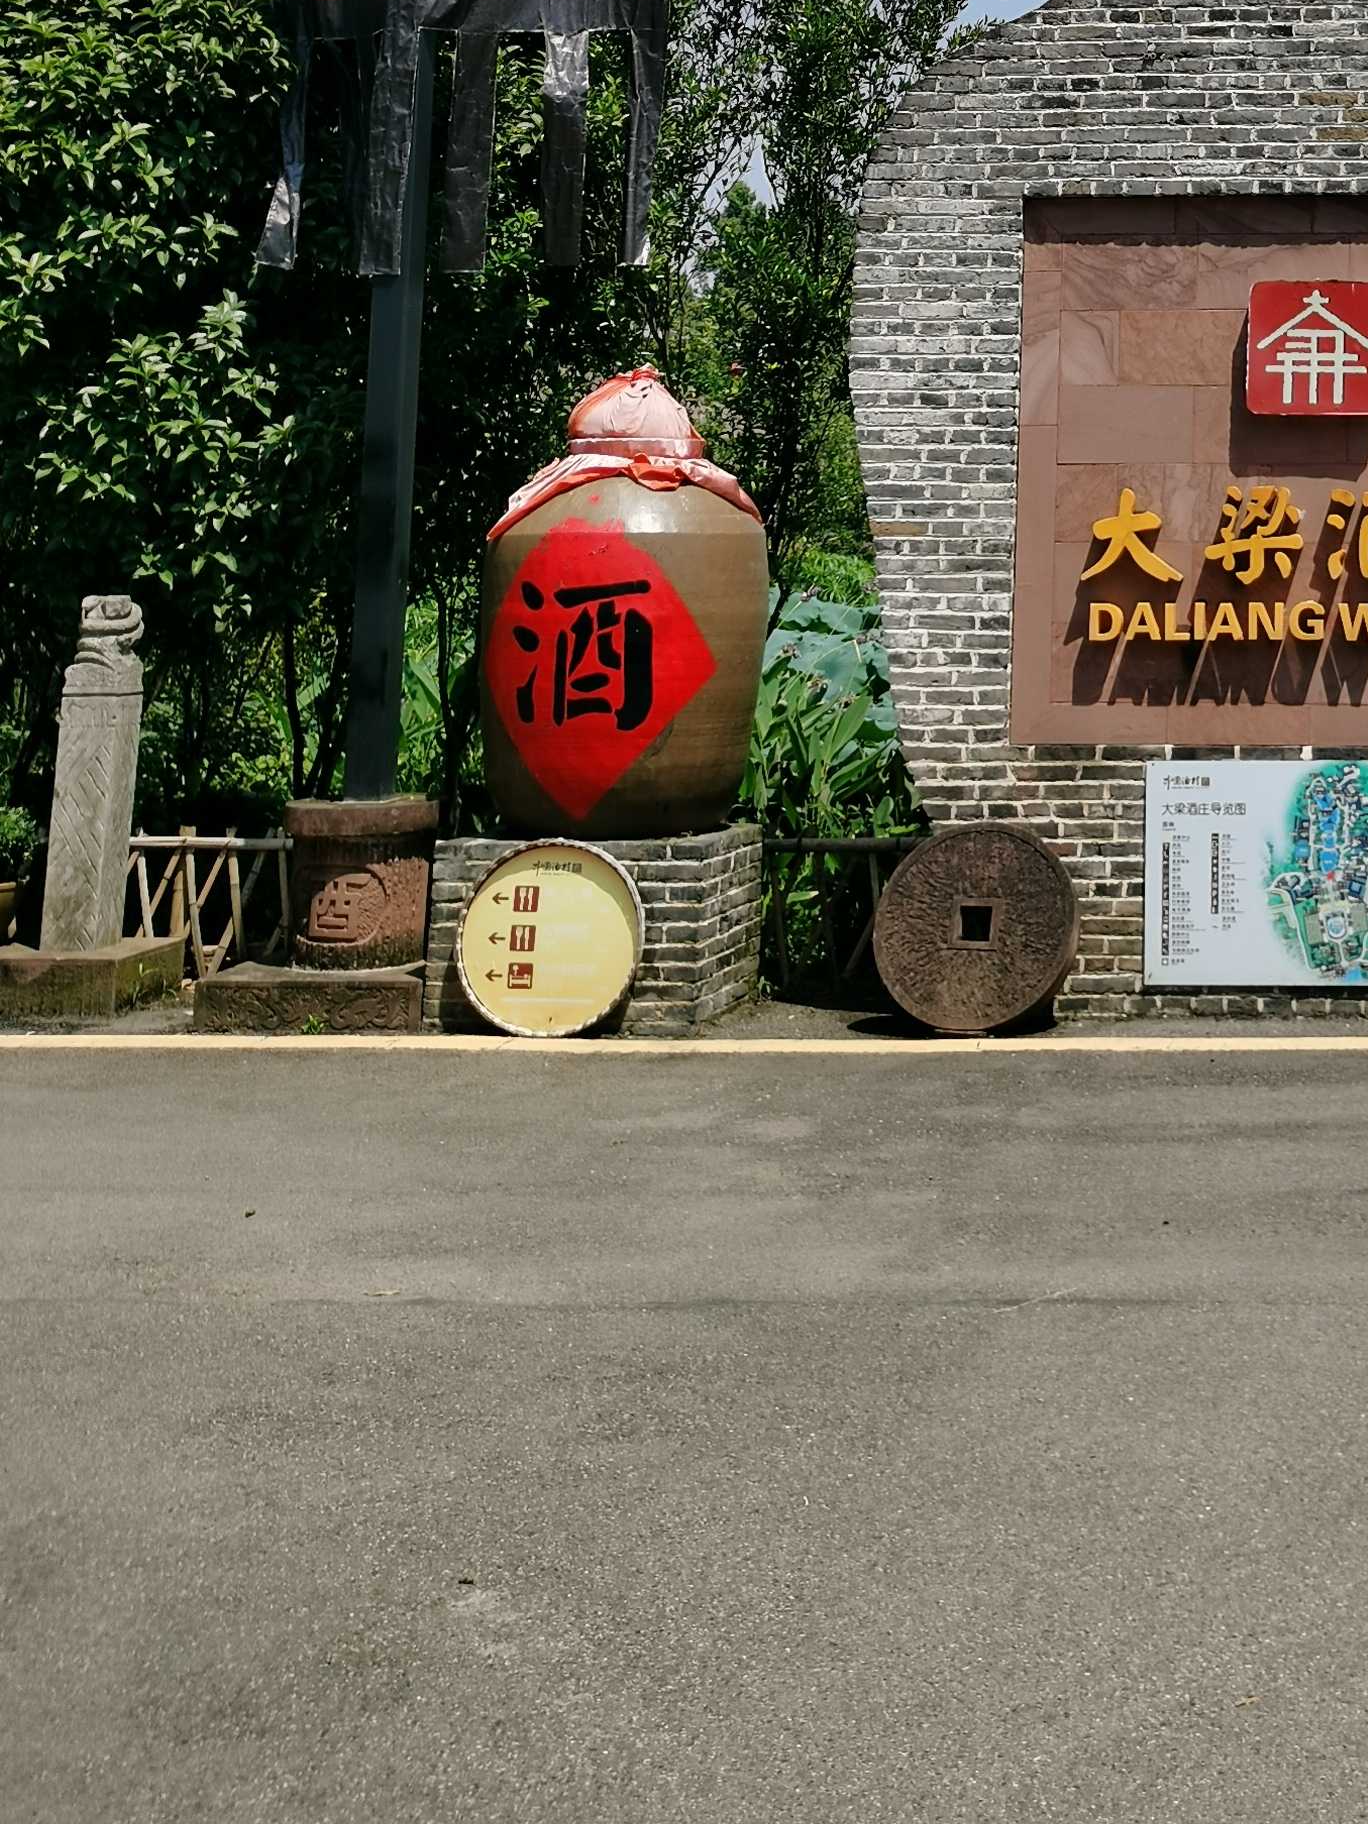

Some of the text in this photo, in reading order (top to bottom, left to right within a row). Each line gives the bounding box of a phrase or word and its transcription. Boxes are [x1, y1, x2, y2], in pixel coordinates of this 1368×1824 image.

[1088, 601, 1324, 642] DALIANG
[513, 579, 653, 732] 酒
[1161, 802, 1246, 816] 大梁酒庄导览图
